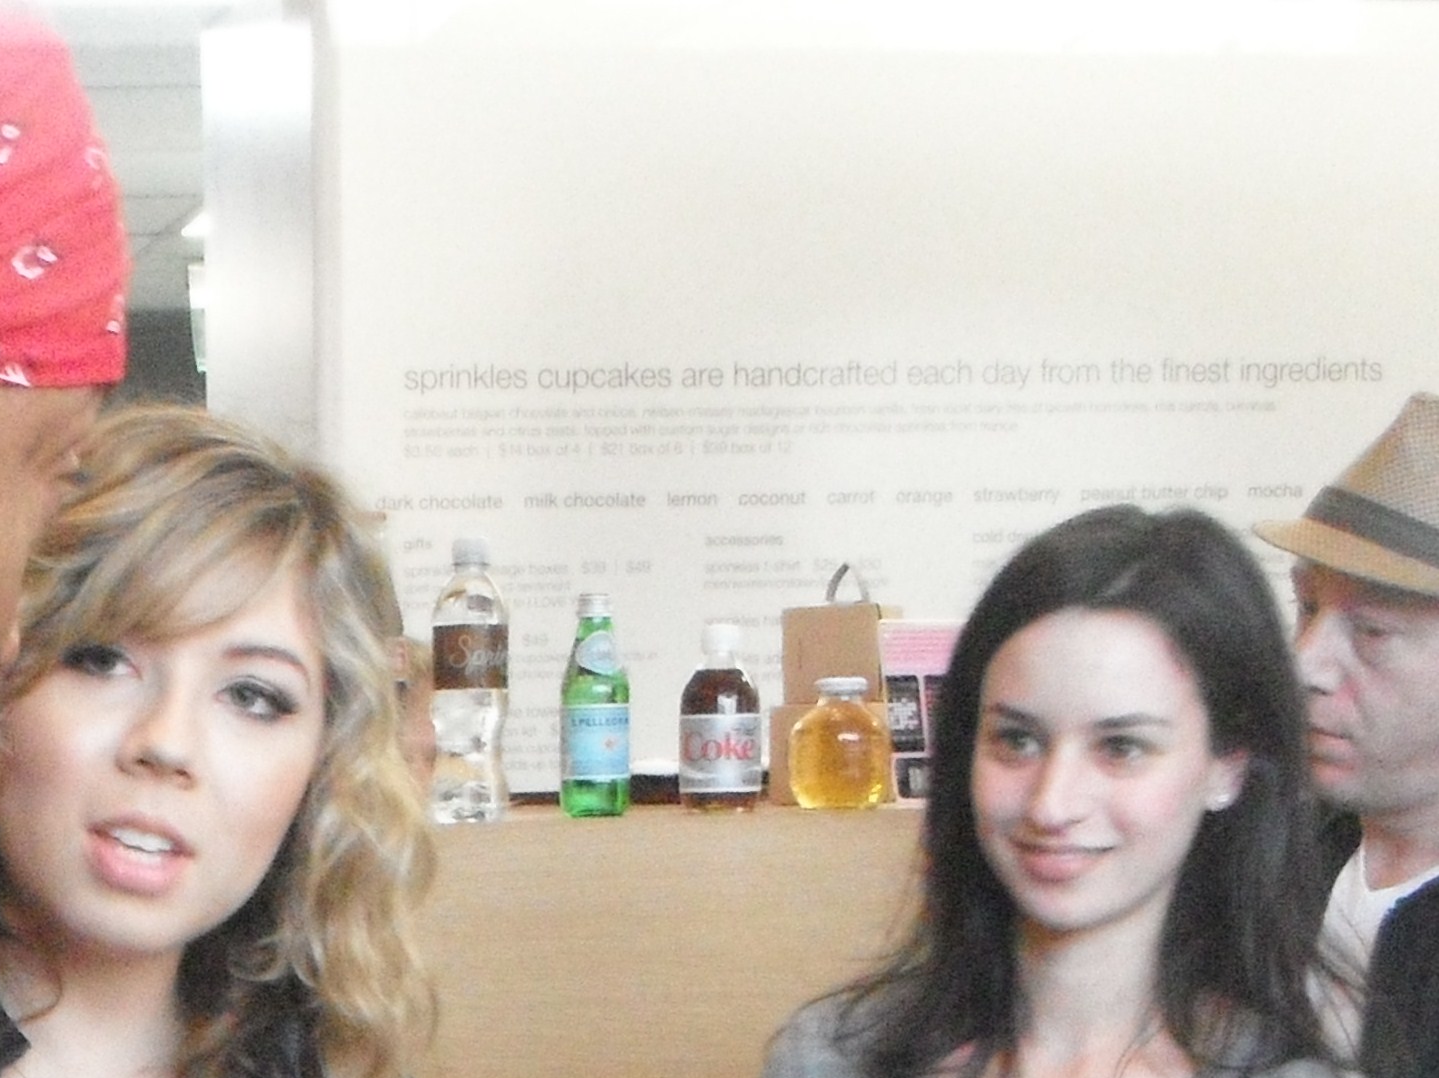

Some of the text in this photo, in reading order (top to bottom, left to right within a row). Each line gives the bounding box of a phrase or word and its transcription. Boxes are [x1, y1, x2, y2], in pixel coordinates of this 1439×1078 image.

[403, 356, 1383, 395] sprinkles cupcakes are handcrafted each day from the finest ingredients
[523, 491, 646, 508] milk chocolate
[667, 491, 718, 507] lemon
[738, 491, 806, 506] coconut
[827, 490, 875, 505] carrot
[896, 490, 953, 507] orange
[973, 487, 1060, 505] strawberry
[1080, 484, 1229, 502] peanut butter chip
[1247, 483, 1304, 499] mocha
[375, 493, 503, 510] dark chocolate
[705, 534, 784, 547] accessories
[683, 730, 757, 761] Coke
